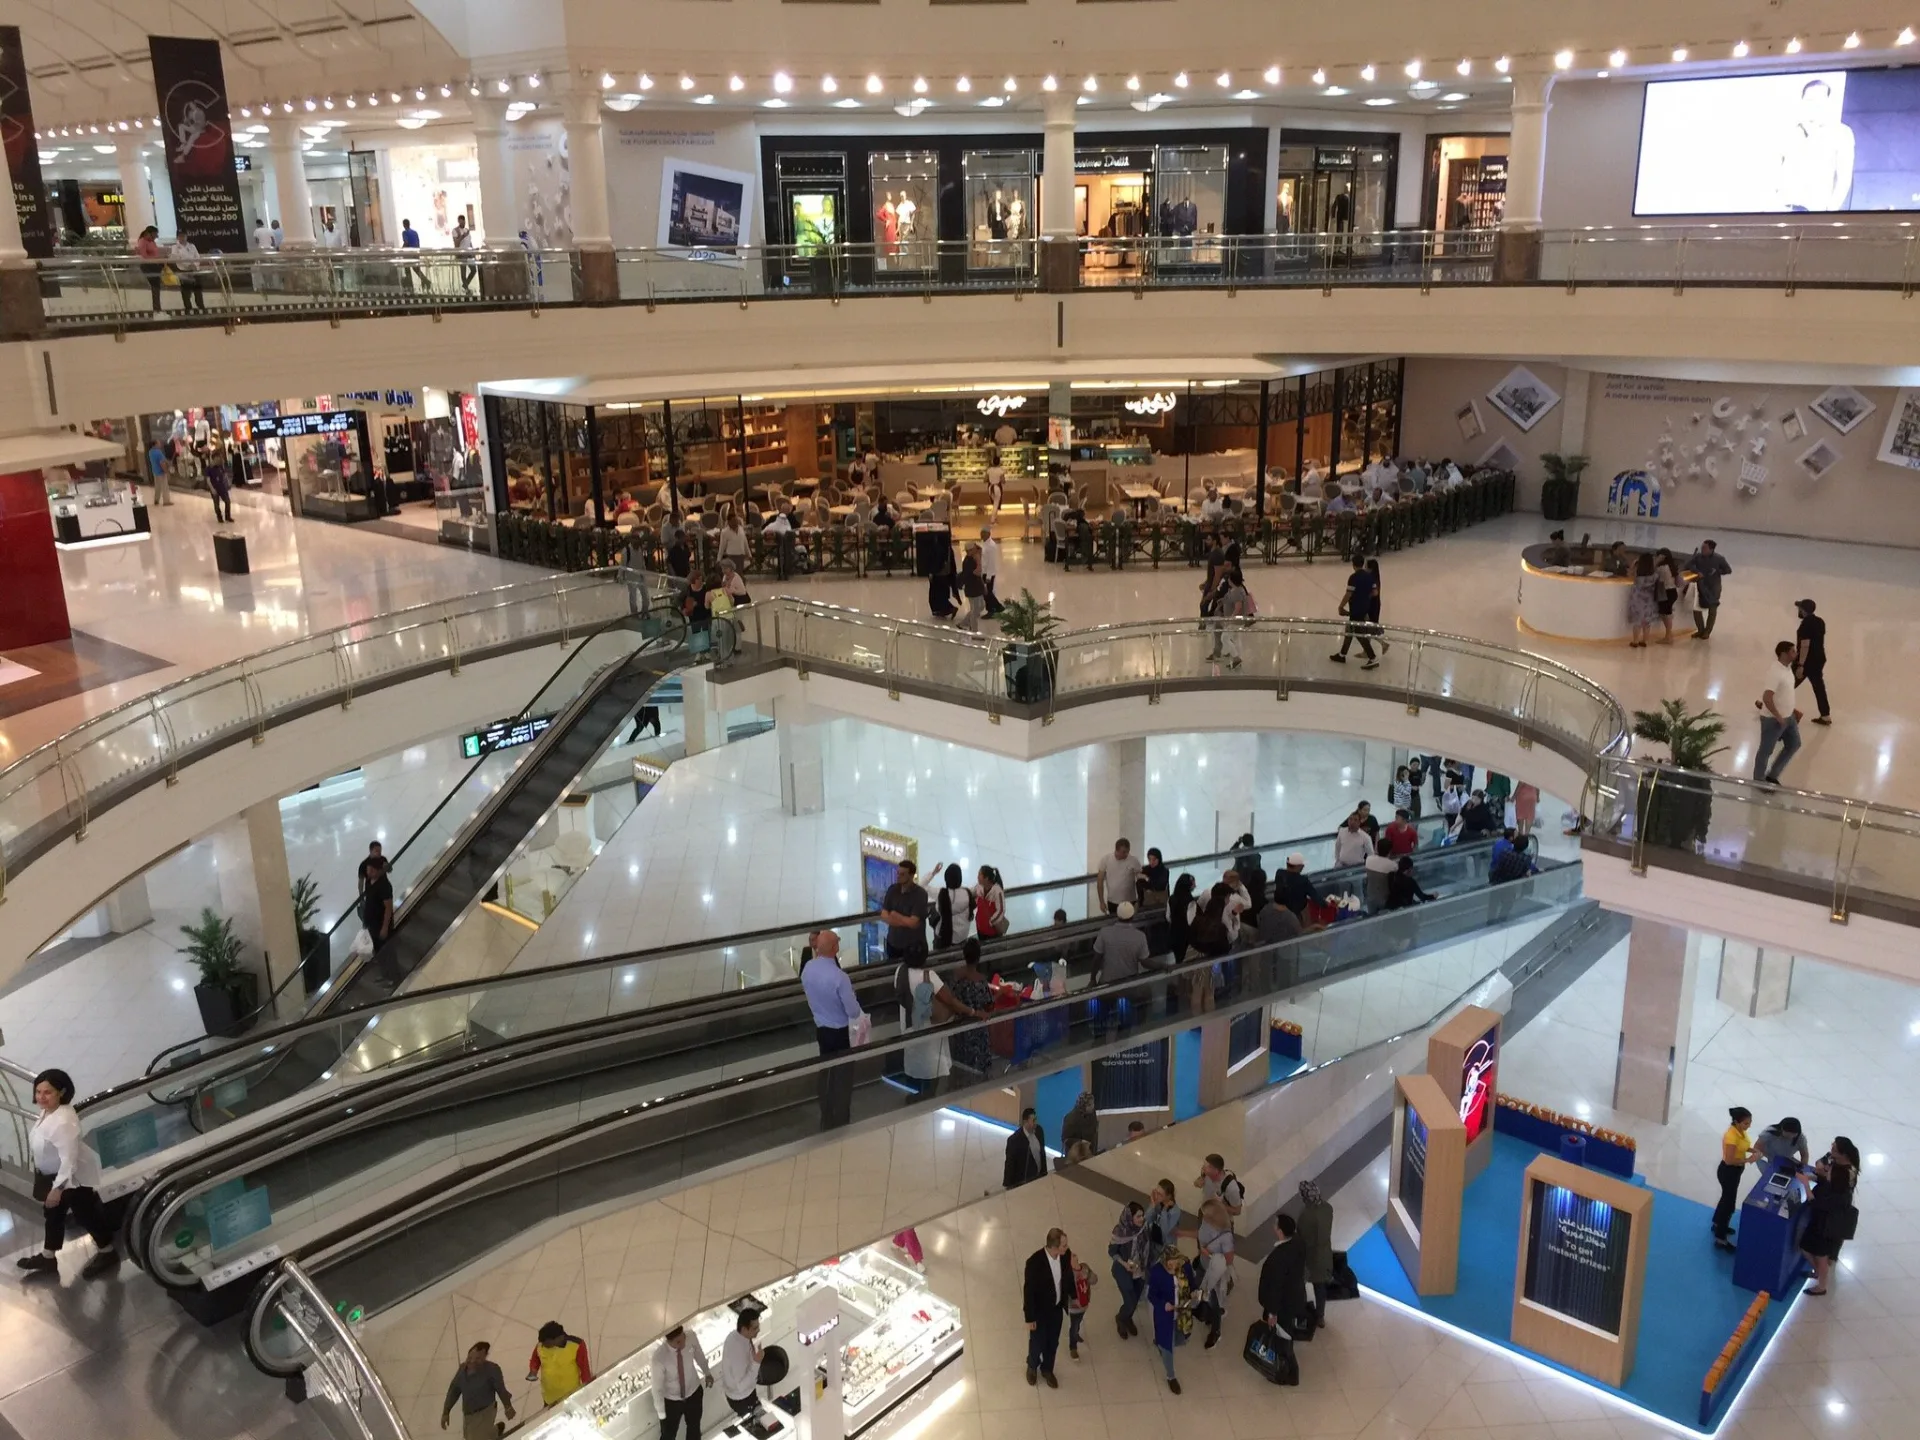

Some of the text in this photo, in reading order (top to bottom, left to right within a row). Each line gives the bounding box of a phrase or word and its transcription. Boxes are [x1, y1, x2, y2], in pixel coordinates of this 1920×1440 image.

[16, 204, 36, 212] Card
[688, 250, 716, 261] 2020
[1606, 382, 1622, 390] Just
[1558, 1218, 1608, 1239] لتحصل على
[1565, 1240, 1594, 1258] To get
